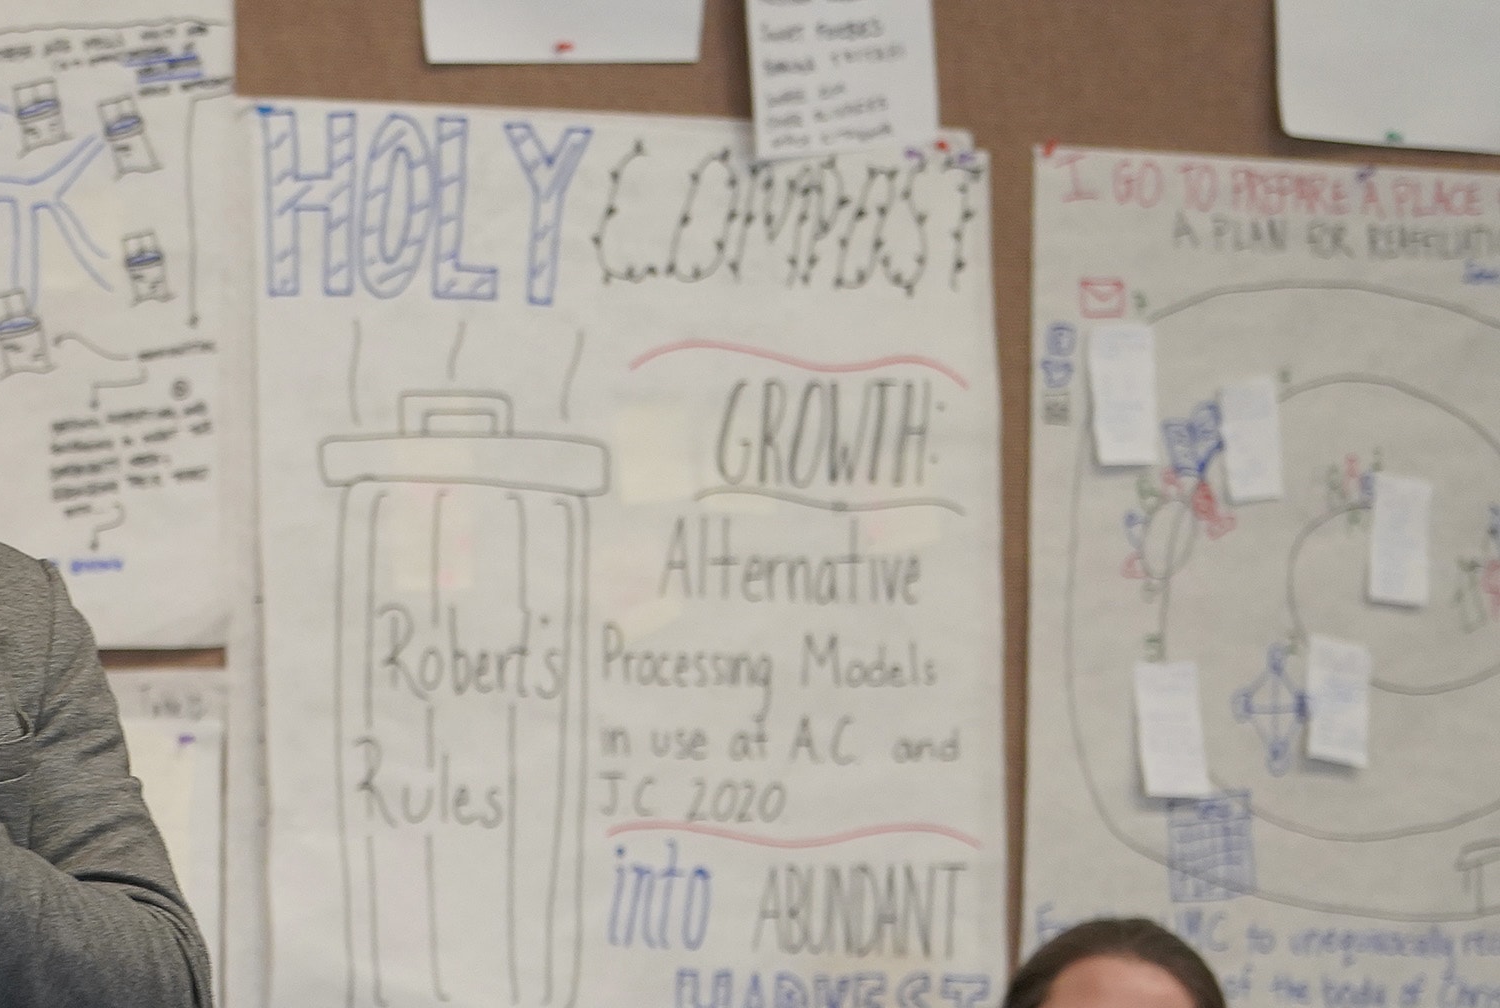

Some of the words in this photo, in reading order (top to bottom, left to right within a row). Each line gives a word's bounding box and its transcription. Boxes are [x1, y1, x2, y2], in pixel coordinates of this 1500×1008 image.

[262, 106, 593, 305] HOLY
[1112, 158, 1163, 209] GO
[1177, 161, 1218, 213] TO
[1392, 178, 1484, 218] PLACE
[657, 514, 923, 605] Alternative
[601, 620, 773, 724] Processing
[800, 631, 938, 689] Models
[352, 736, 506, 828] Rules
[650, 727, 708, 761] use
[891, 726, 962, 764] and
[685, 776, 788, 823] 2020
[606, 840, 714, 950] into
[750, 861, 968, 960] ABUNDANT
